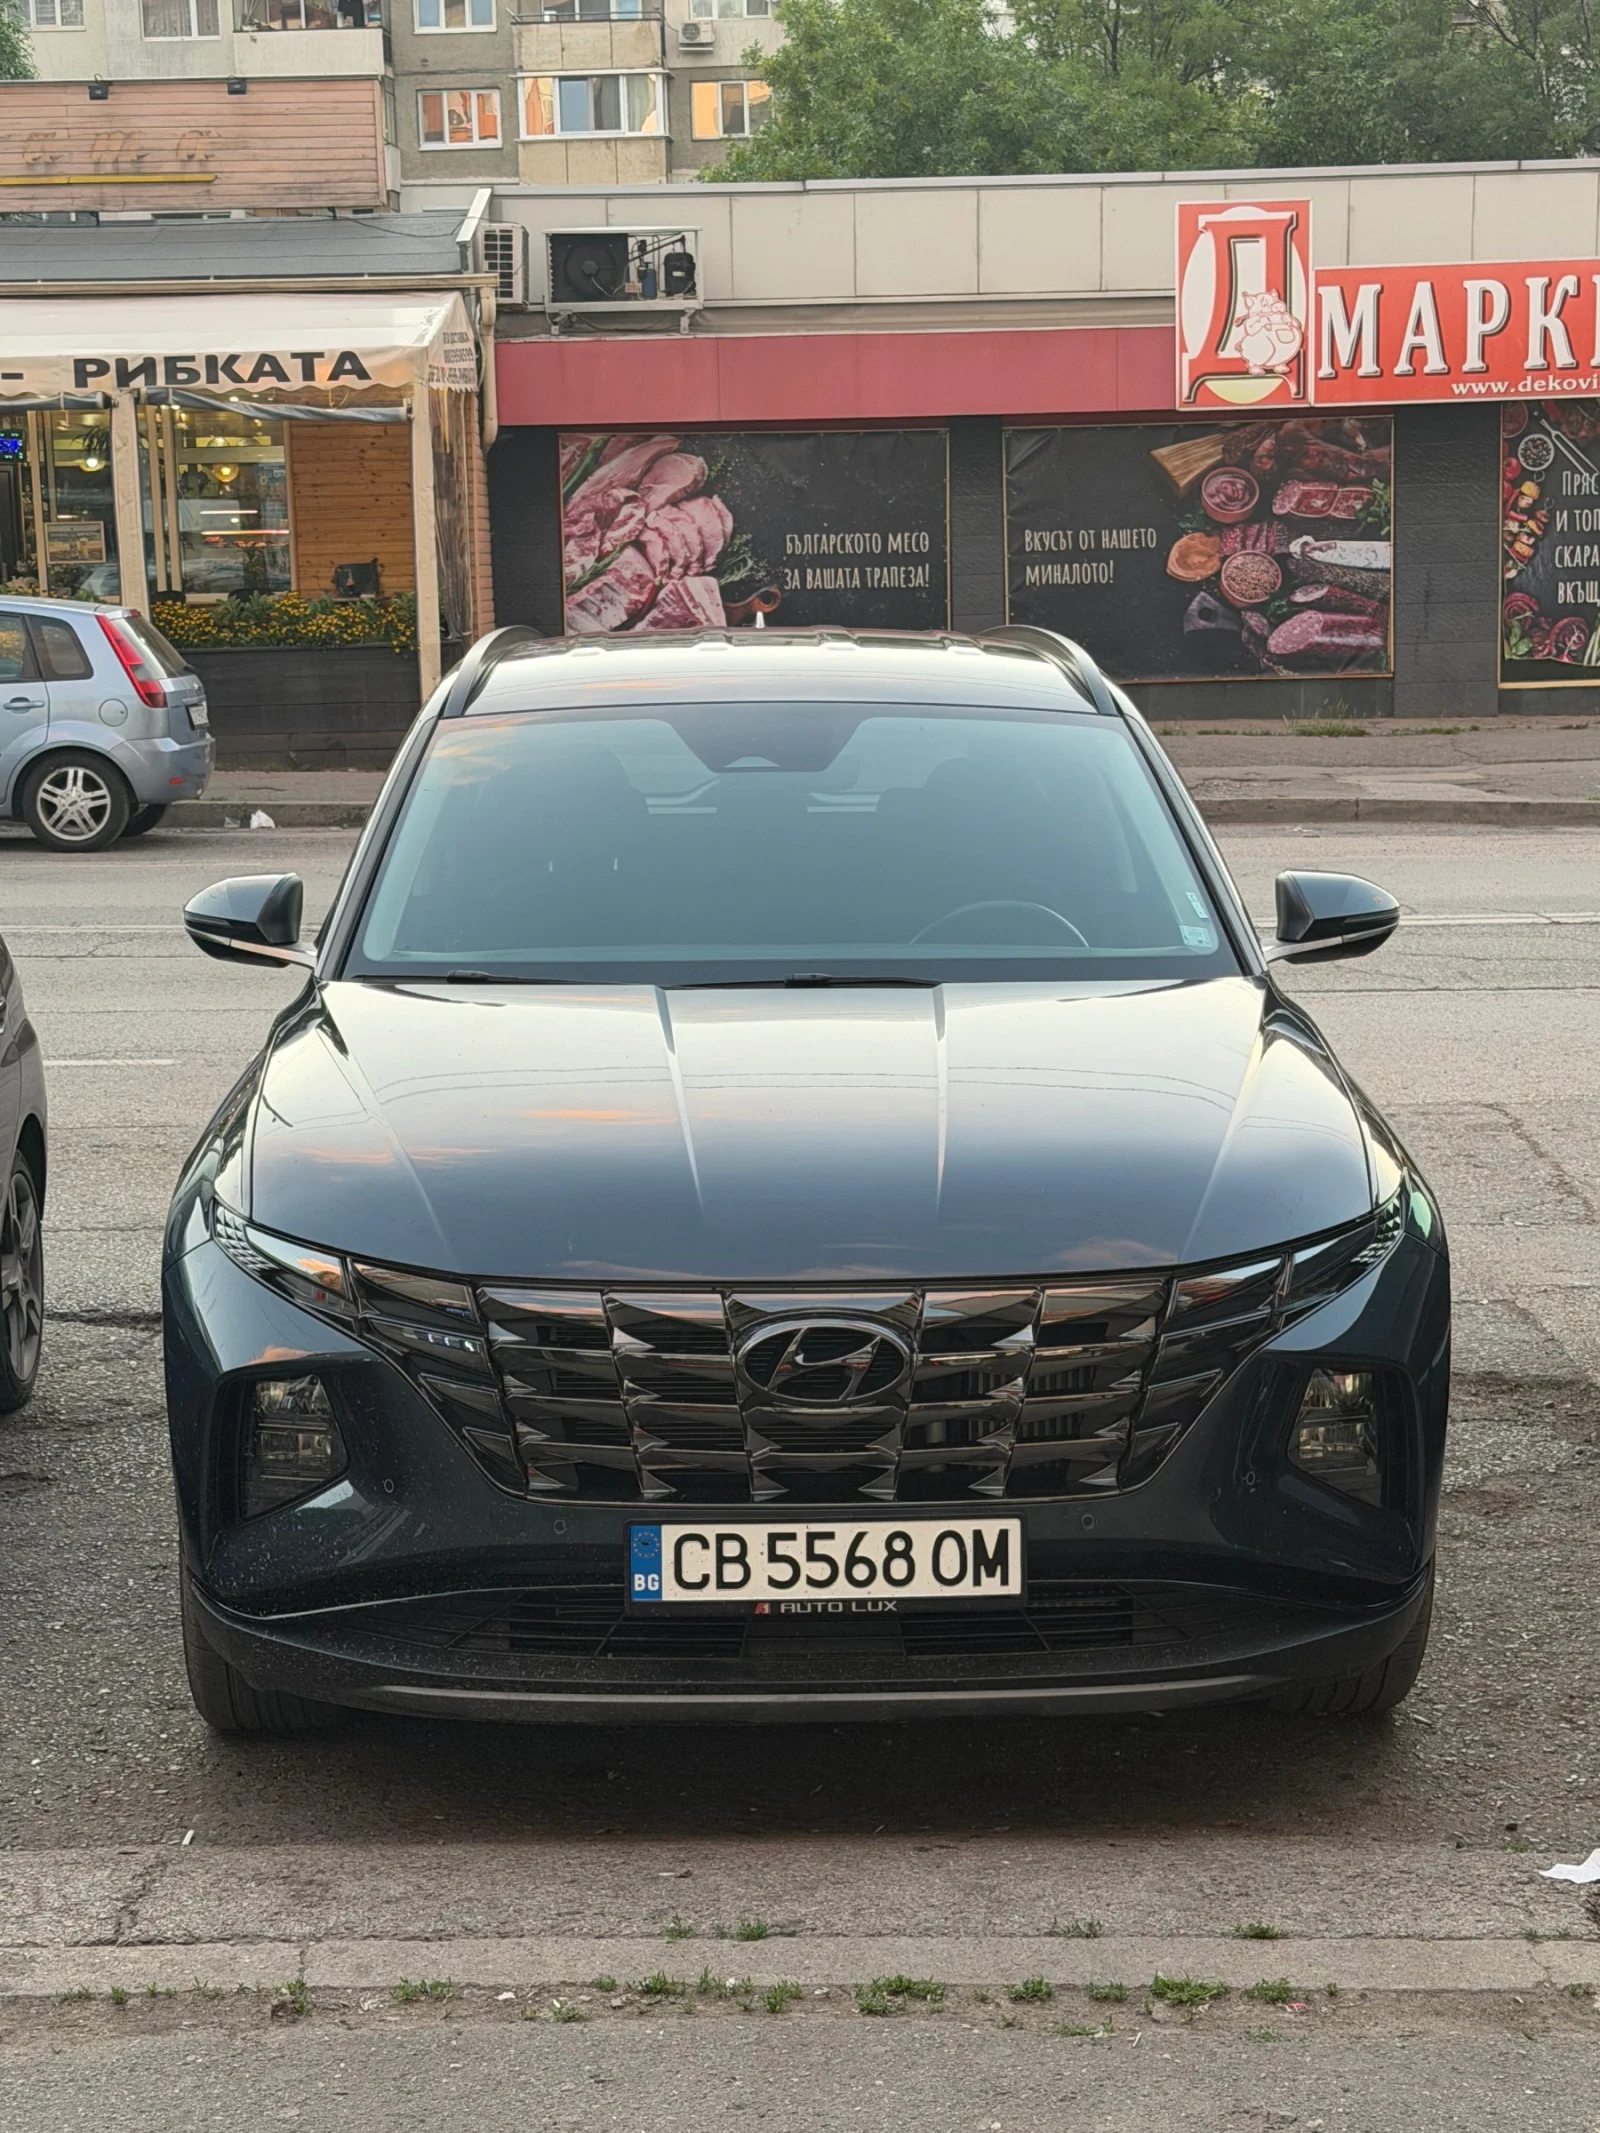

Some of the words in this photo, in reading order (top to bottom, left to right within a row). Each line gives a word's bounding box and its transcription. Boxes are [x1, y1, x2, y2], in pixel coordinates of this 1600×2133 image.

[1318, 274, 1600, 379] МАРК
[73, 350, 372, 389] РИБКАТА
[1555, 509, 1568, 532] И
[786, 532, 882, 555] БЪЛГАРСКОТО
[888, 531, 930, 554] МЕСО
[1079, 529, 1095, 550] ОТ
[1102, 528, 1157, 549] НАШЕТО
[1555, 544, 1600, 568] СКАРА
[784, 568, 801, 590] ЗА
[806, 567, 861, 590] ВАШАТА
[865, 563, 930, 588] ТРАПЕЗА!
[1026, 560, 1114, 587] МИНАЛОТО!
[1558, 580, 1600, 607] ВКЪЩ
[674, 1532, 752, 1591] CB
[767, 1530, 915, 1590] 5568
[634, 1573, 660, 1592] BG
[780, 1601, 844, 1614] AUTO
[851, 1600, 898, 1612] LUX
